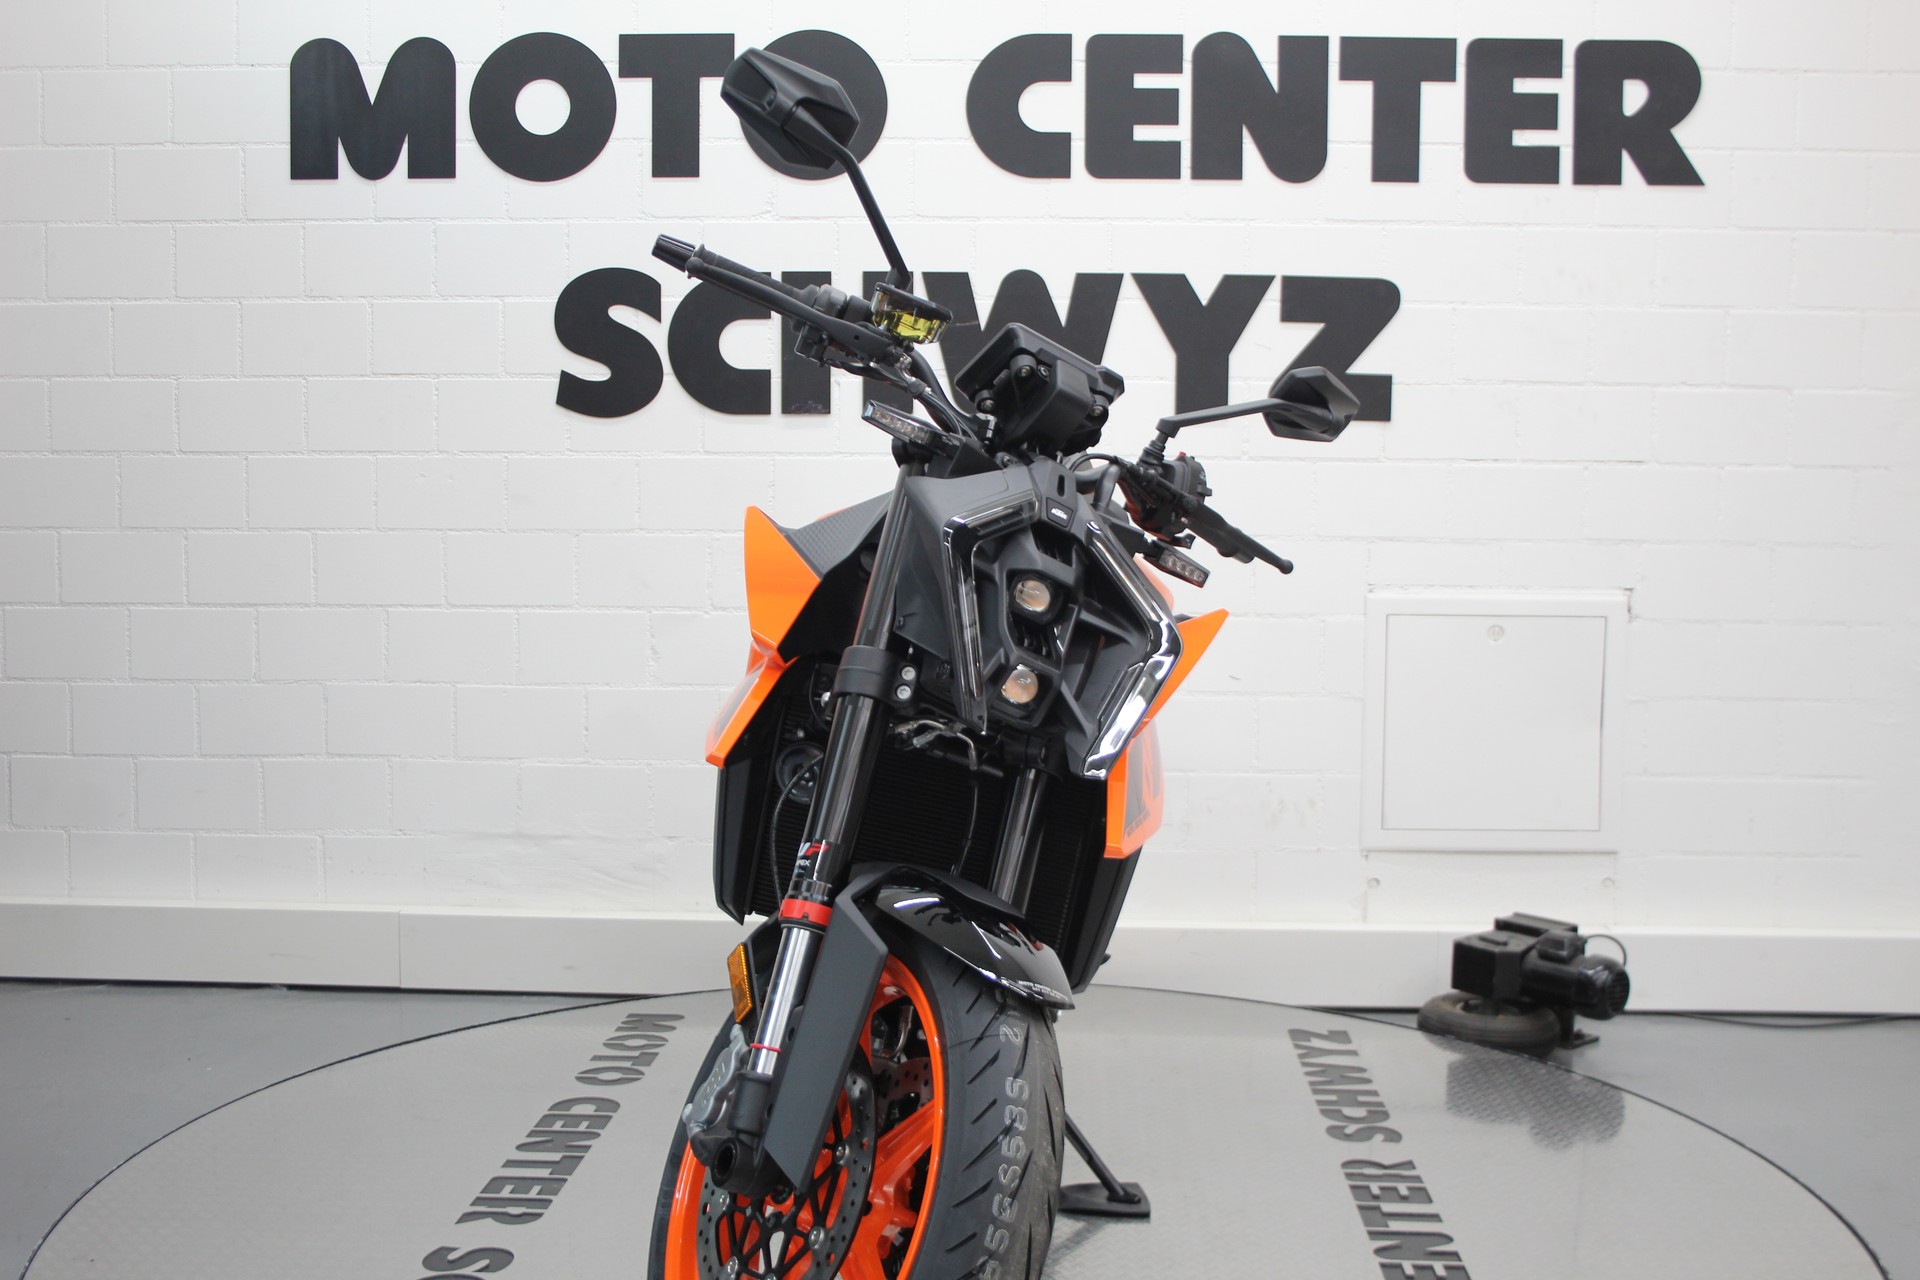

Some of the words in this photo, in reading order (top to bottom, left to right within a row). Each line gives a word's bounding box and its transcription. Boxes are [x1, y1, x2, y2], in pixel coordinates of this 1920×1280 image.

[290, 29, 887, 182] MOTO
[965, 31, 1705, 186] CENTER
[575, 1013, 685, 1086] MOTO
[1288, 1028, 1403, 1143] SCHWYZ
[455, 1096, 621, 1225] CENTER
[416, 1246, 515, 1280] S
